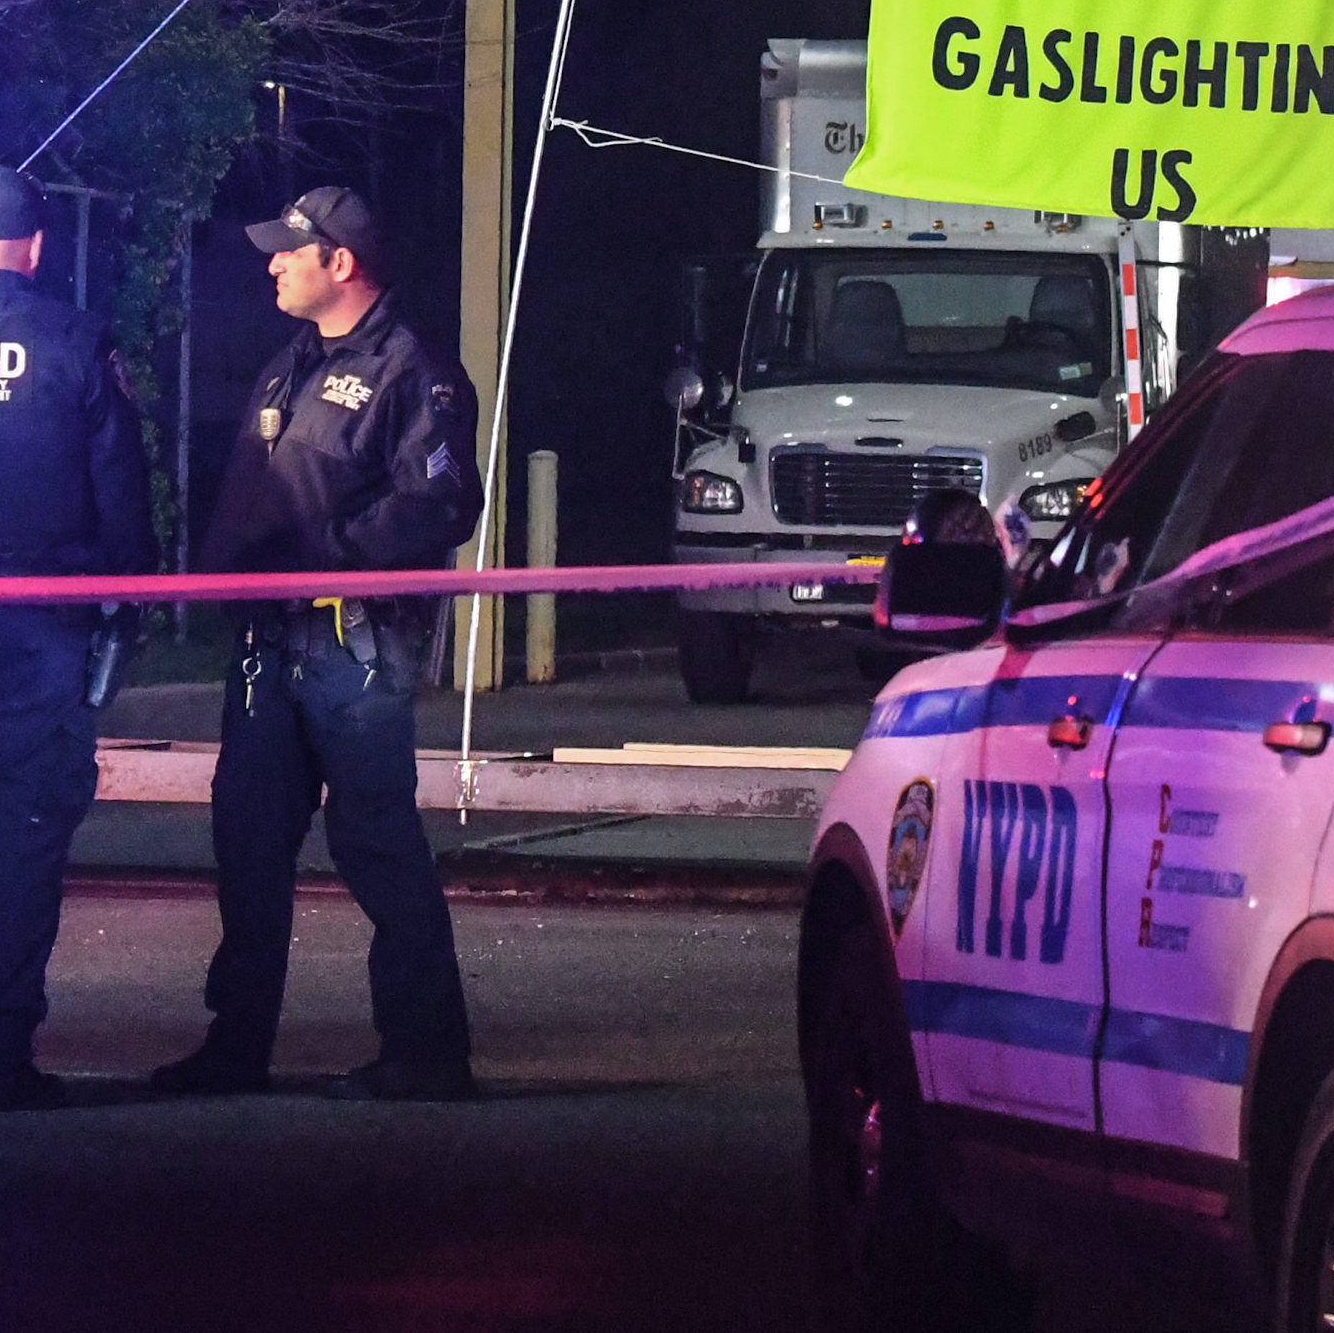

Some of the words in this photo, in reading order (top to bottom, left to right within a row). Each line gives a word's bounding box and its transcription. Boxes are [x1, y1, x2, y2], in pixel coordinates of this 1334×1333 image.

[1110, 148, 1197, 224] US
[323, 375, 373, 403] POLICE
[1018, 433, 1053, 462] 8189
[956, 779, 1078, 965] NYPD
